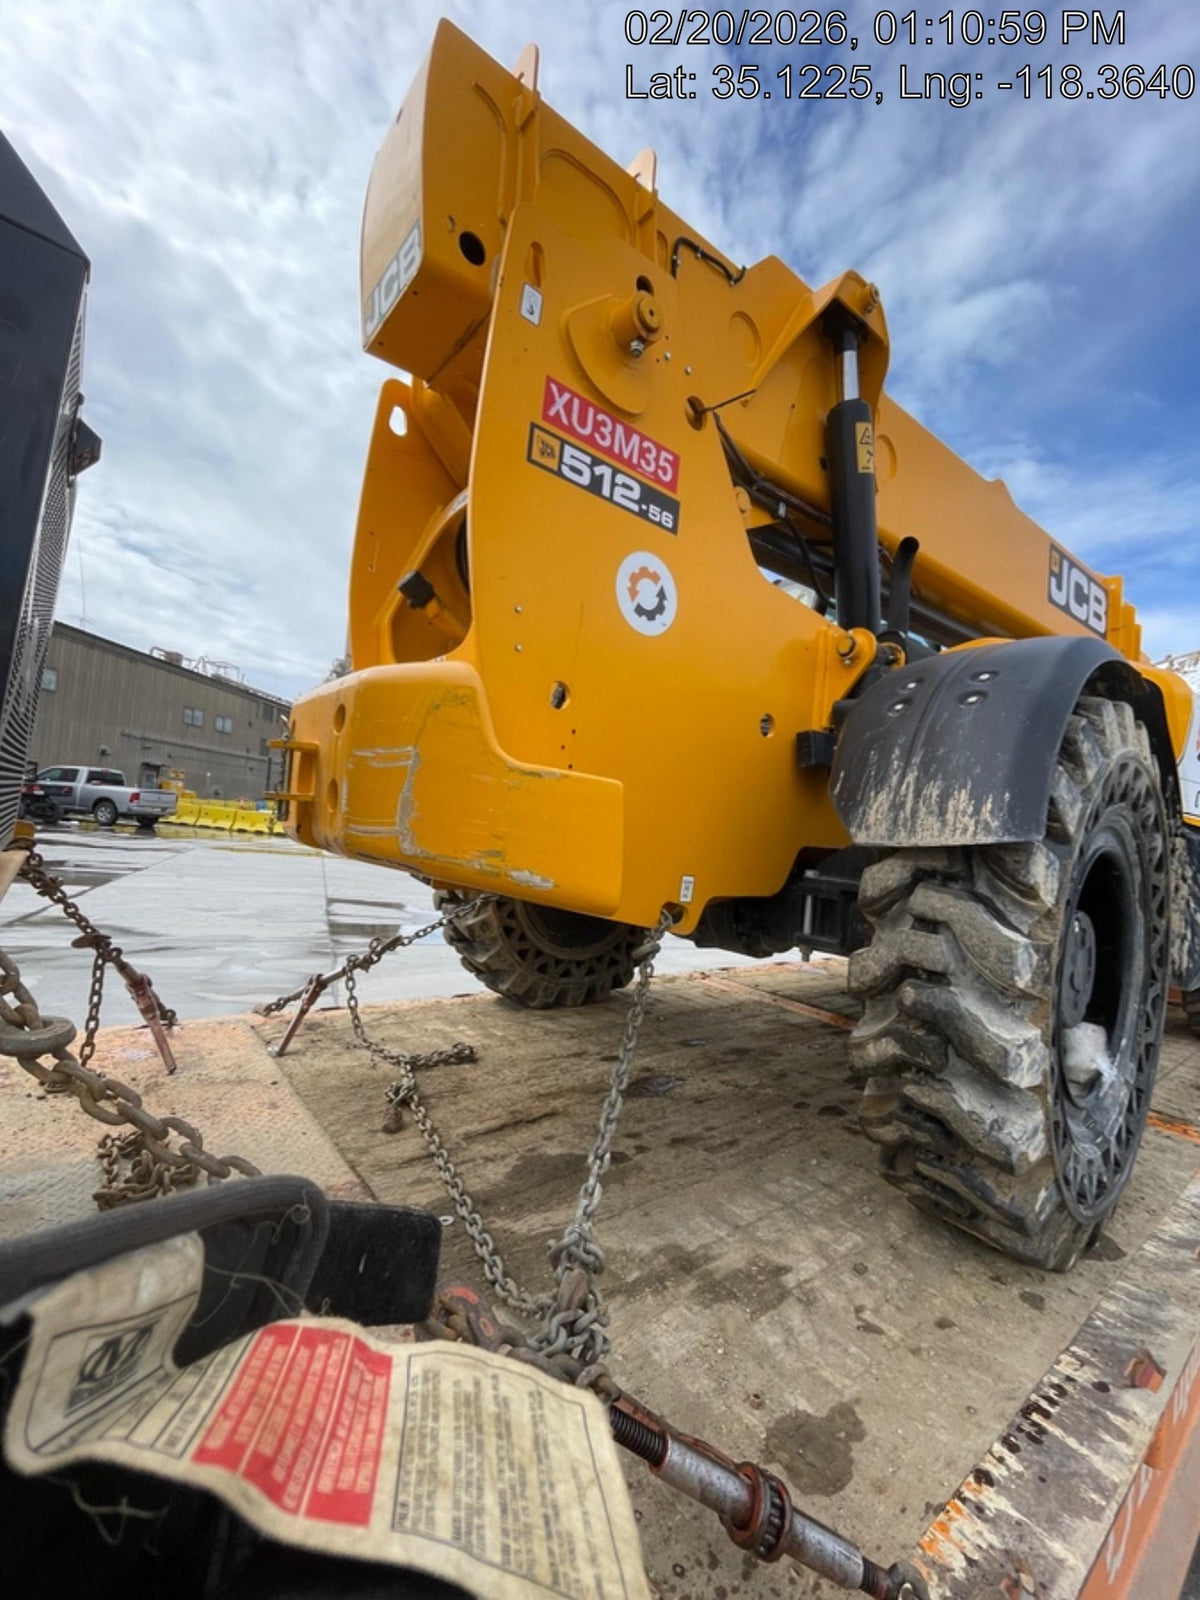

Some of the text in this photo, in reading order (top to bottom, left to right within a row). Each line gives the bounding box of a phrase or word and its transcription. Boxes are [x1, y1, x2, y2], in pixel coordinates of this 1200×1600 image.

[365, 226, 421, 337] JCB
[547, 382, 675, 483] XU3M35
[1050, 558, 1107, 634] JCB
